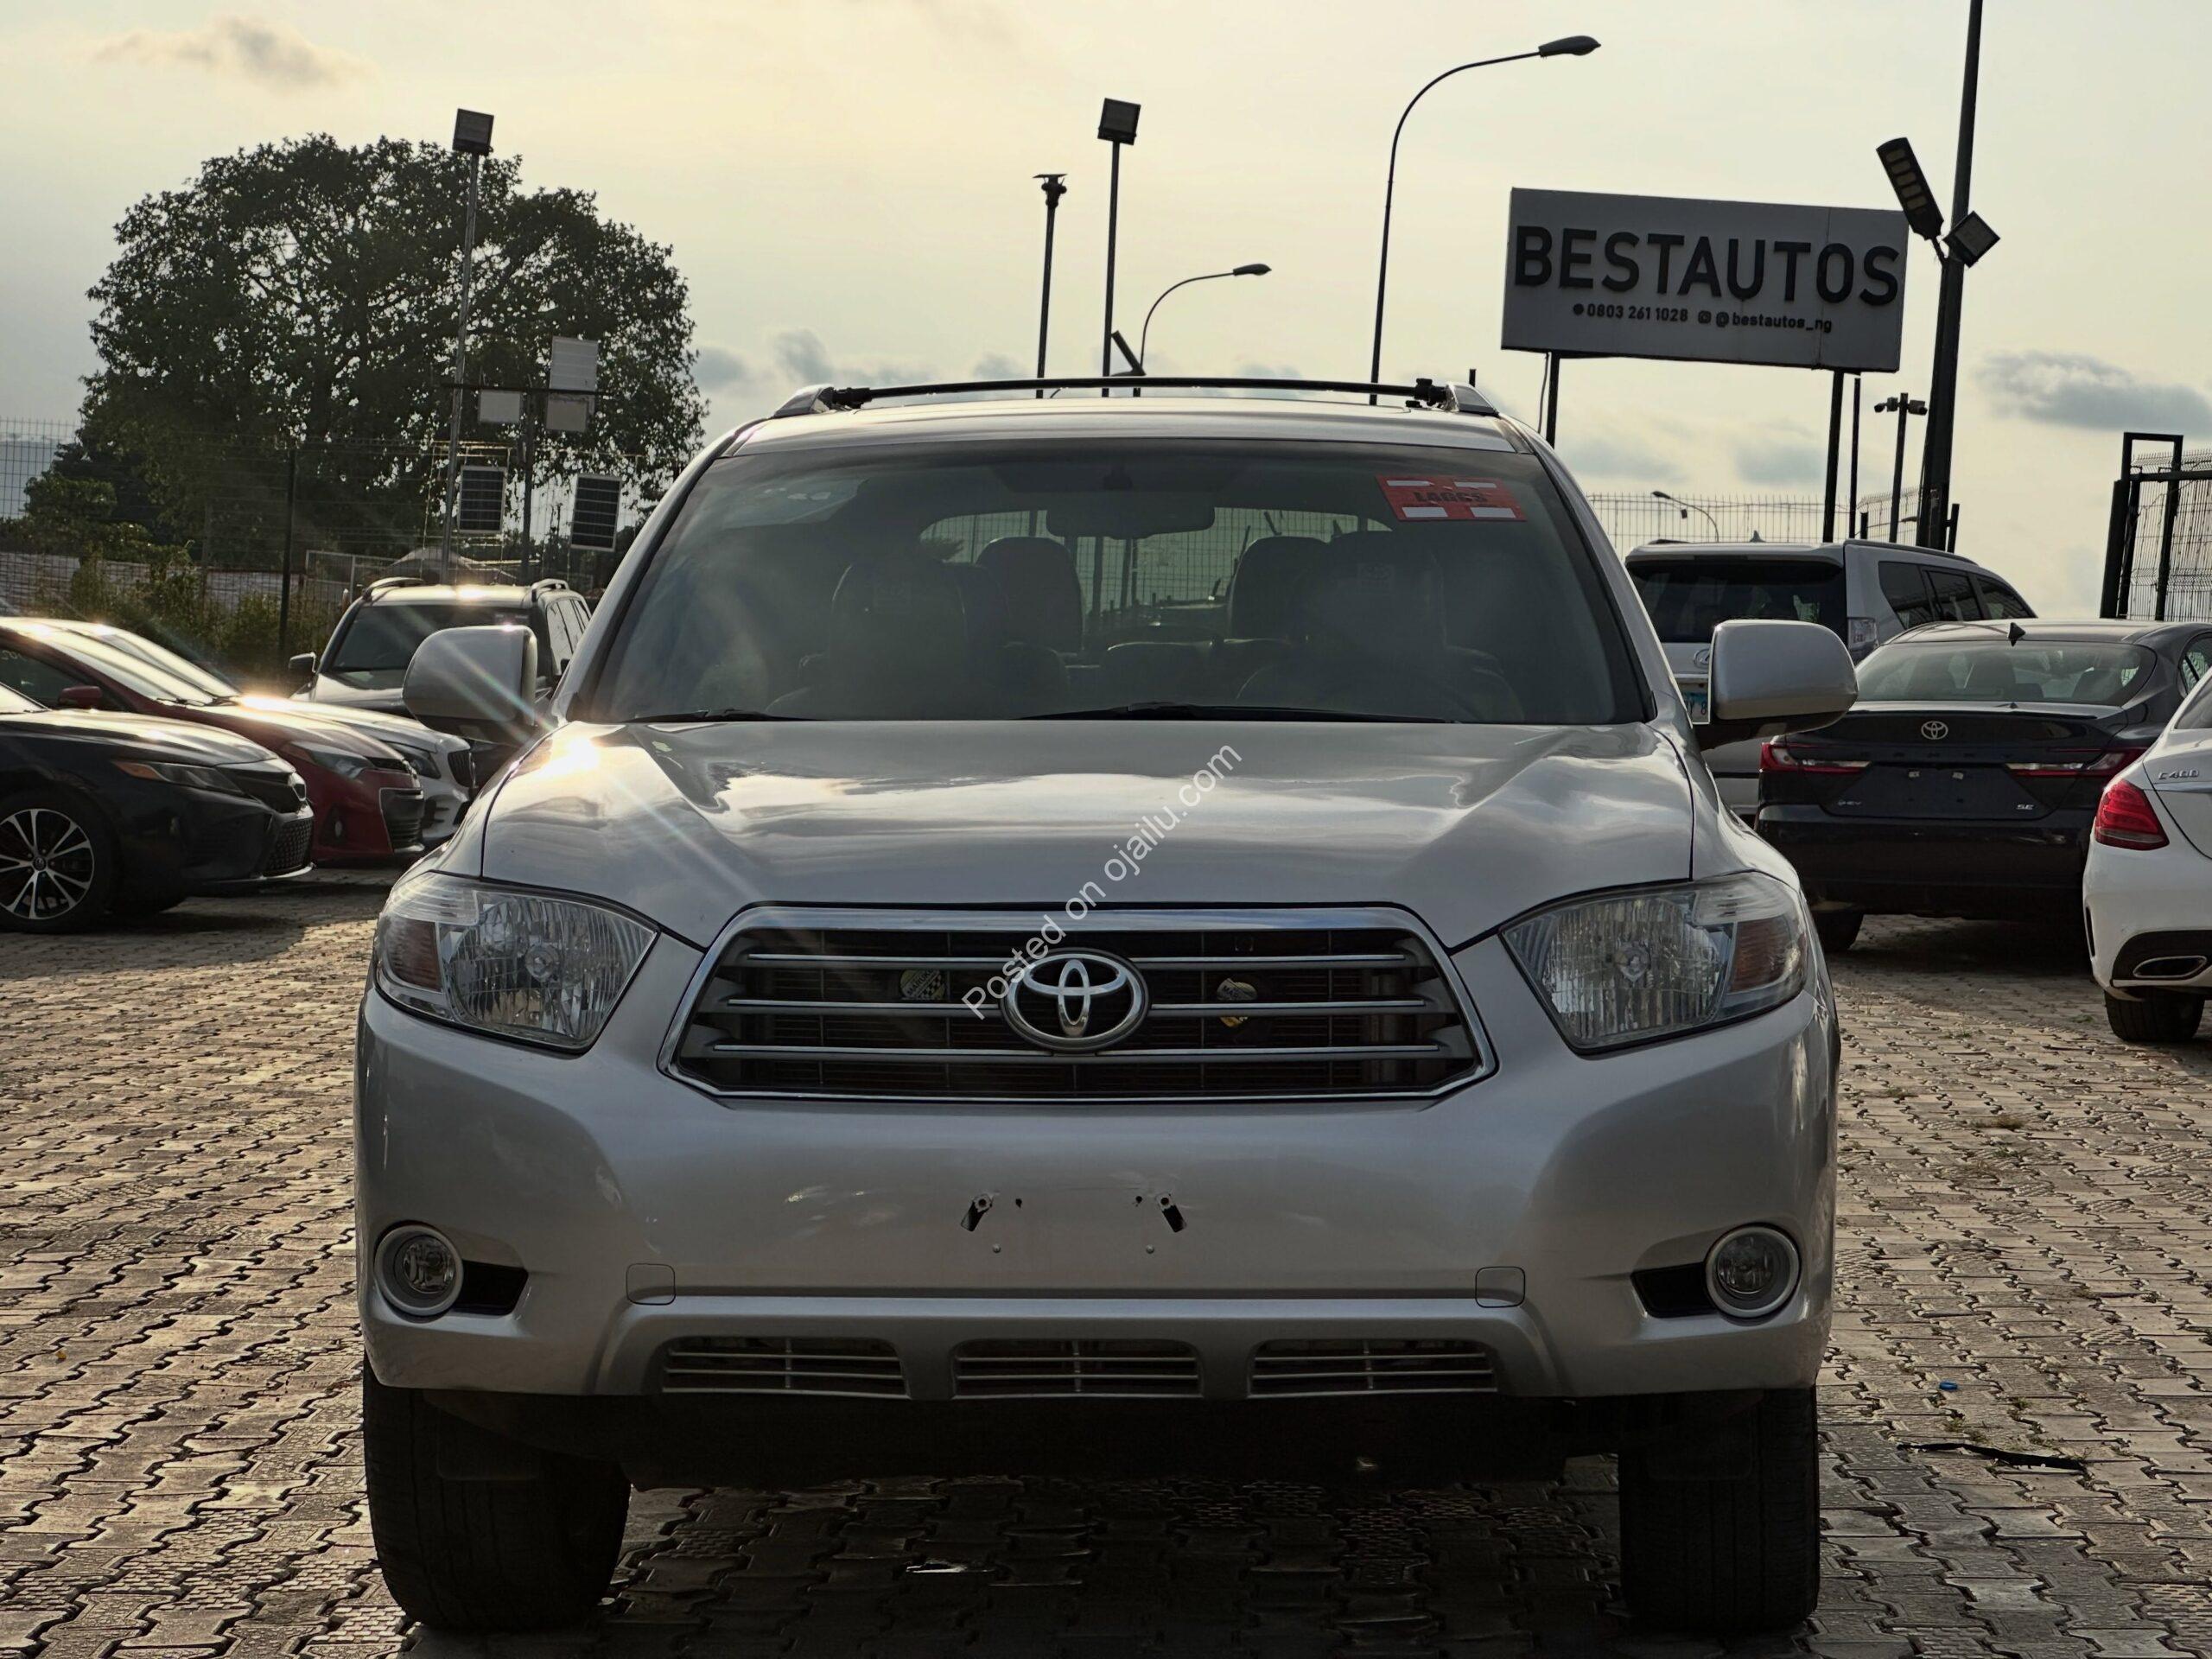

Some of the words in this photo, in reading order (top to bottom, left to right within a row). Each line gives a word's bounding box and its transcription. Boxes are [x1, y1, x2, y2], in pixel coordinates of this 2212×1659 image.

[1514, 226, 1900, 307] BESTAUTOS
[1586, 304, 1624, 319] 0803
[1628, 306, 1651, 321] 261
[1656, 307, 1688, 322] 1028
